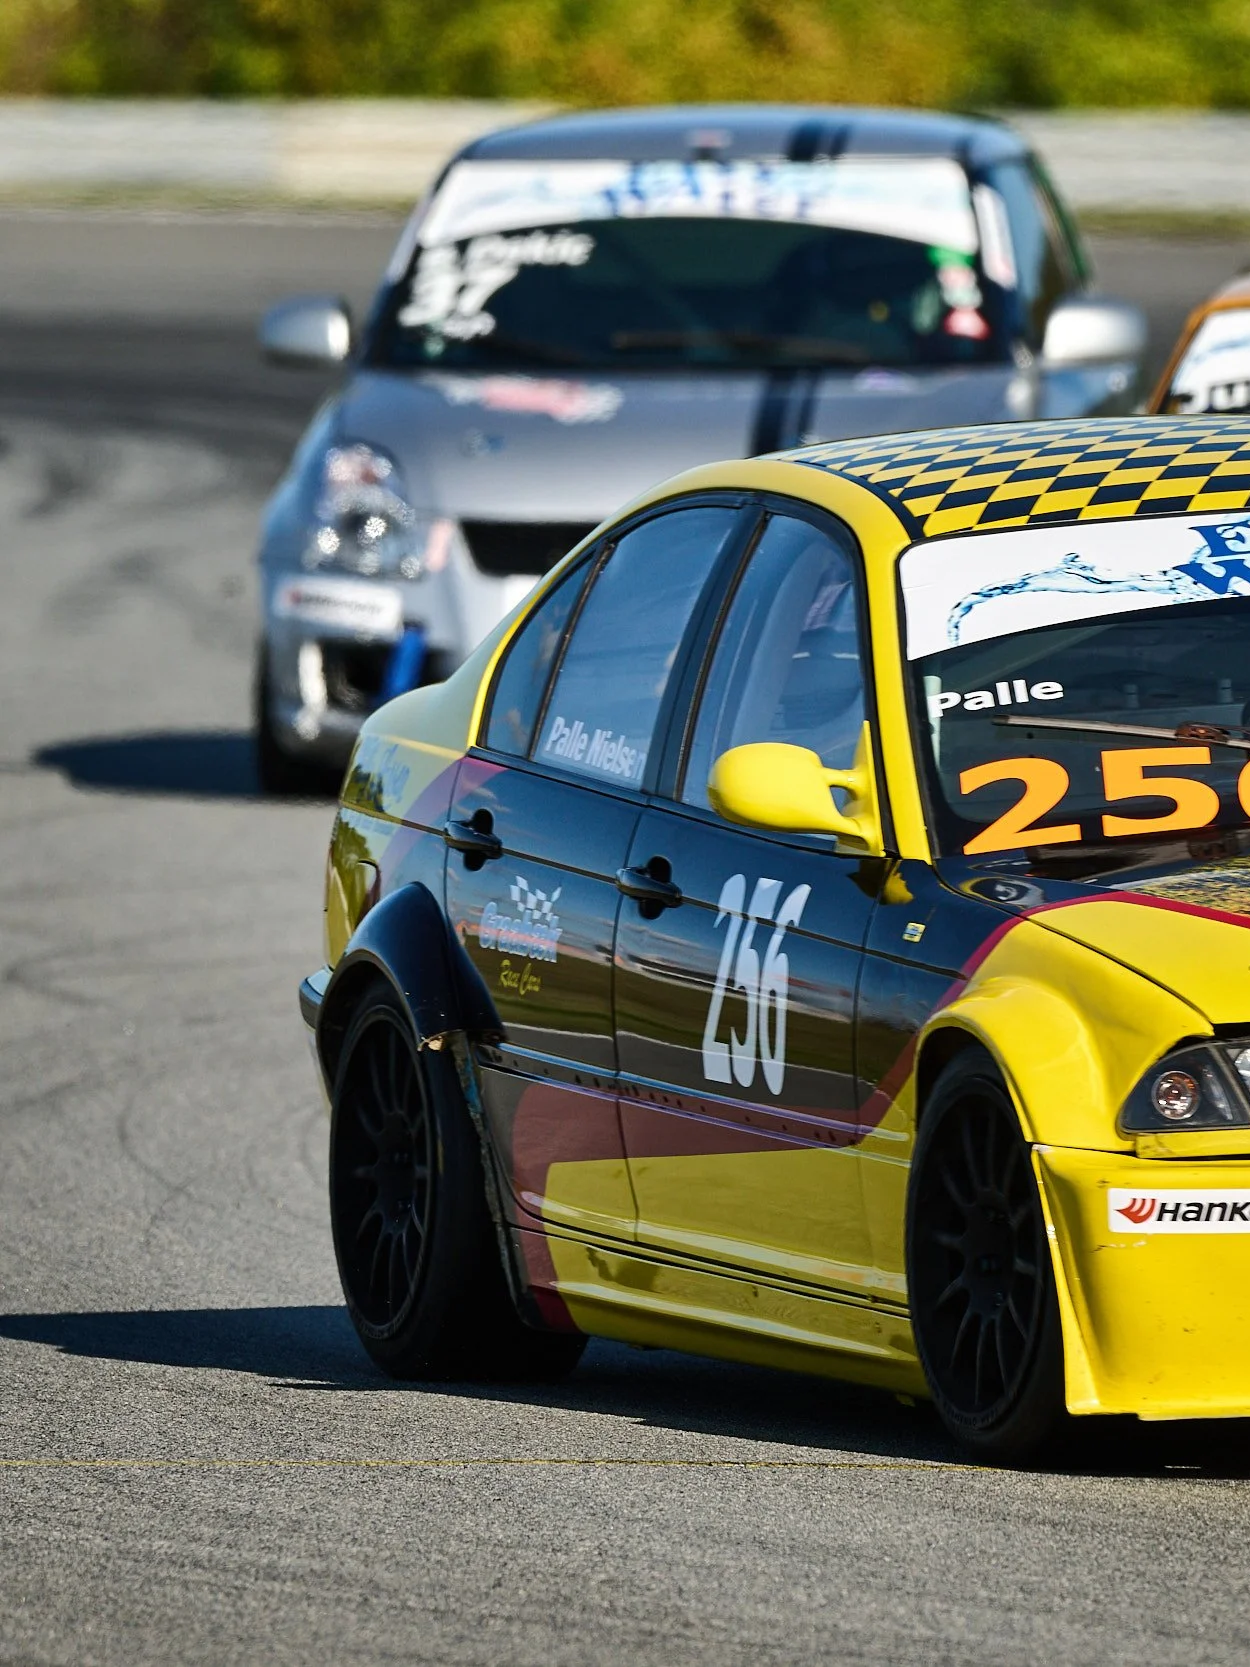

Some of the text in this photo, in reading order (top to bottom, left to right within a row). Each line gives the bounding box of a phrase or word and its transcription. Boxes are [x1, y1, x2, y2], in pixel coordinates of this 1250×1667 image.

[926, 679, 1065, 718] Palle
[545, 716, 648, 780] Palle Nielsen
[702, 873, 812, 1096] 256
